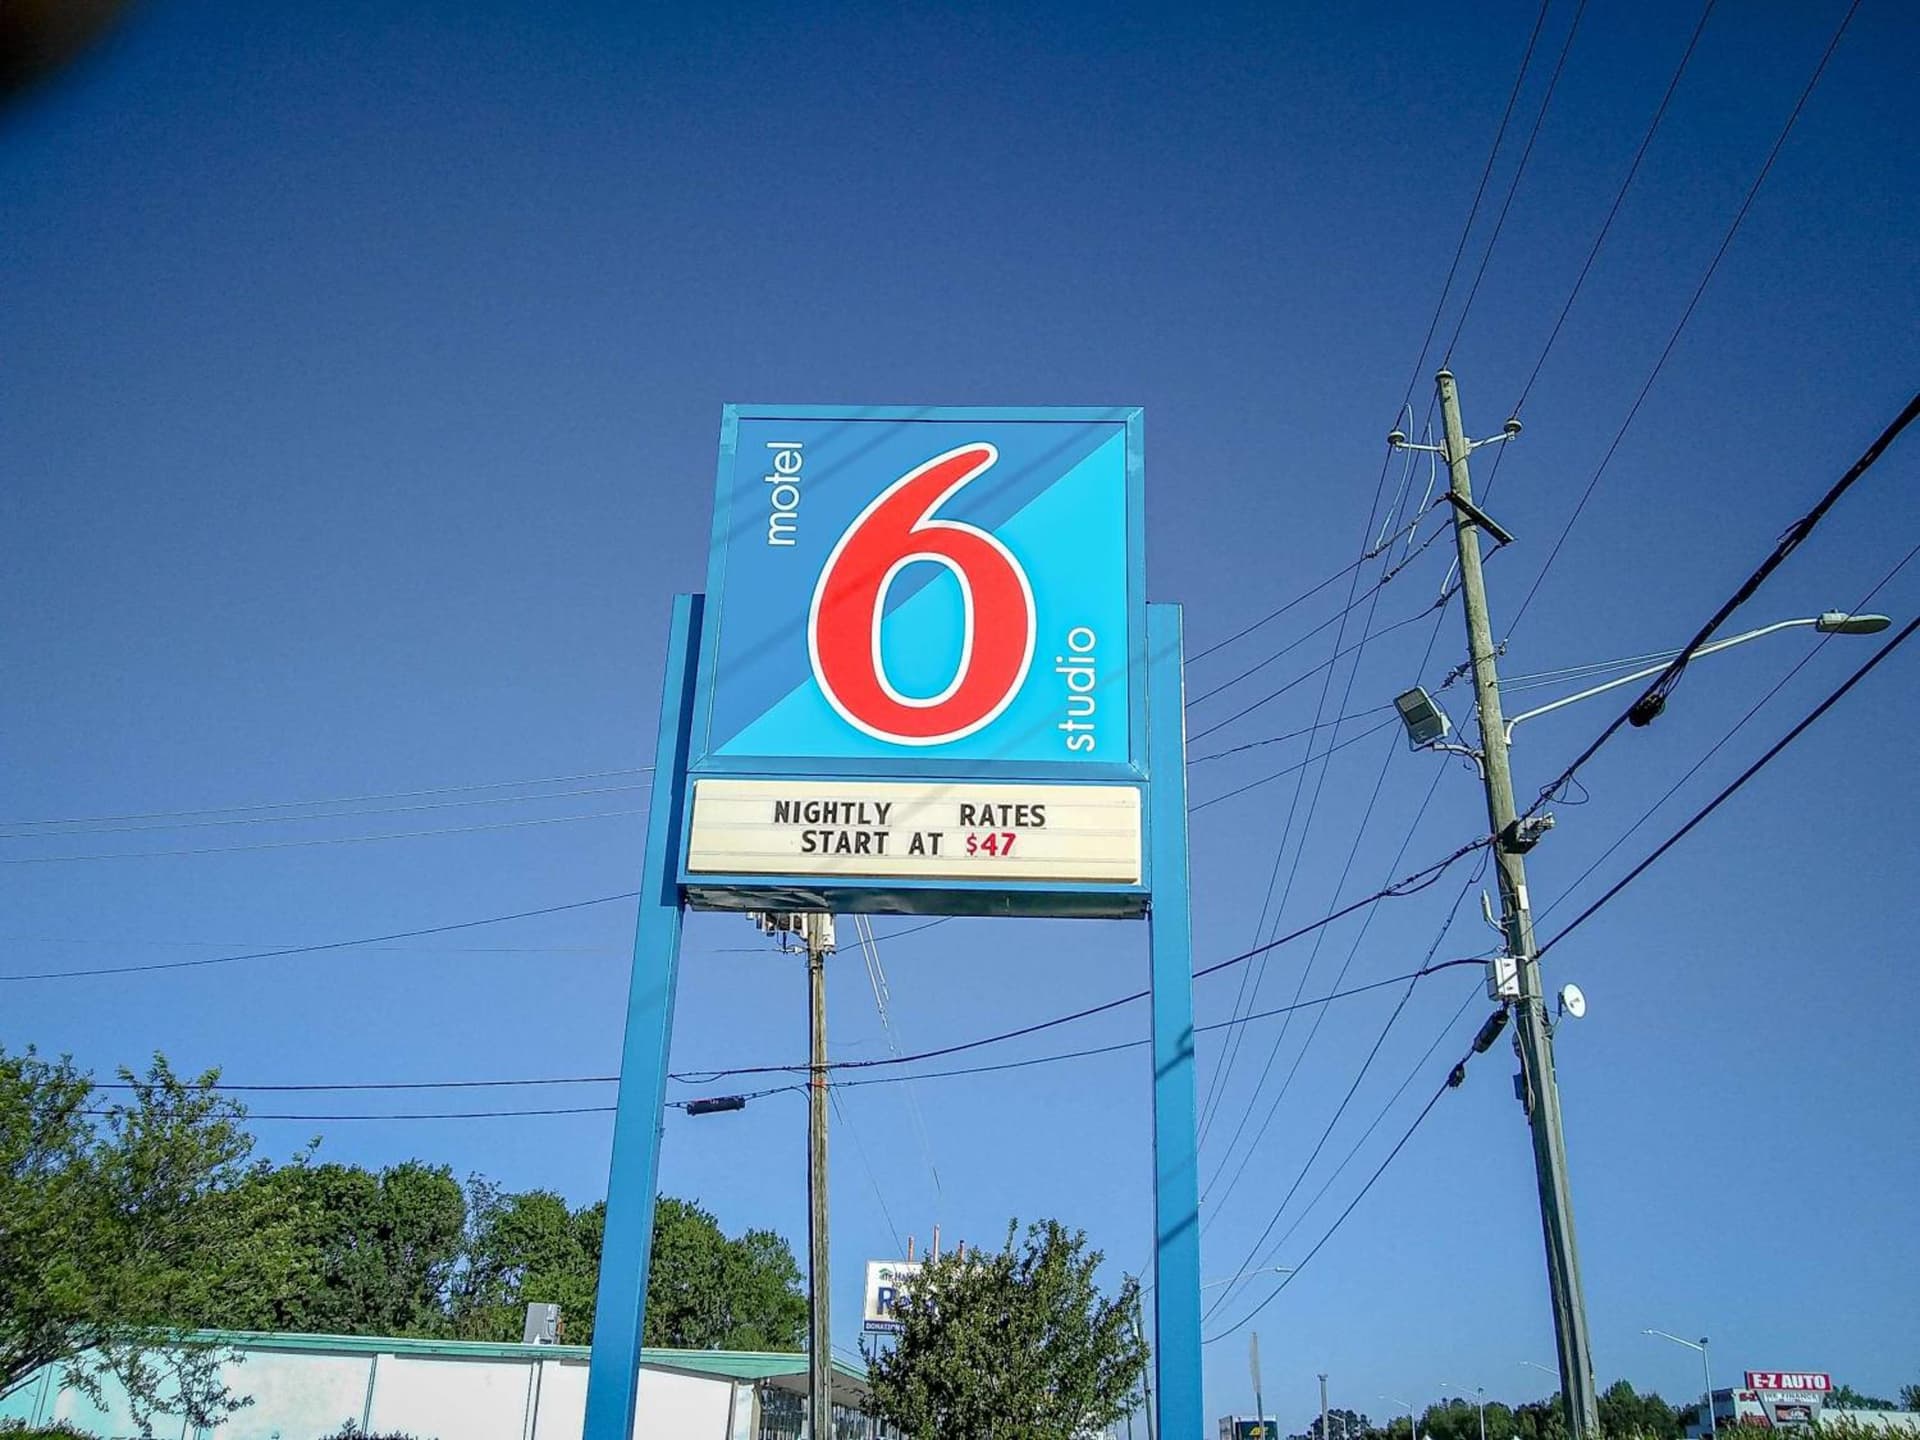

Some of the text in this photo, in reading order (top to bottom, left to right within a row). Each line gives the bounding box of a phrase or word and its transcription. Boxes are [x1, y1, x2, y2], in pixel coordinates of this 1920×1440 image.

[765, 441, 803, 547] motel
[808, 441, 1037, 746] 6
[1055, 626, 1096, 752] studio
[773, 800, 1047, 828] NIGHTLY RATES
[801, 829, 1017, 857] START AT $47
[1752, 1373, 1826, 1389] E-Z AUTO
